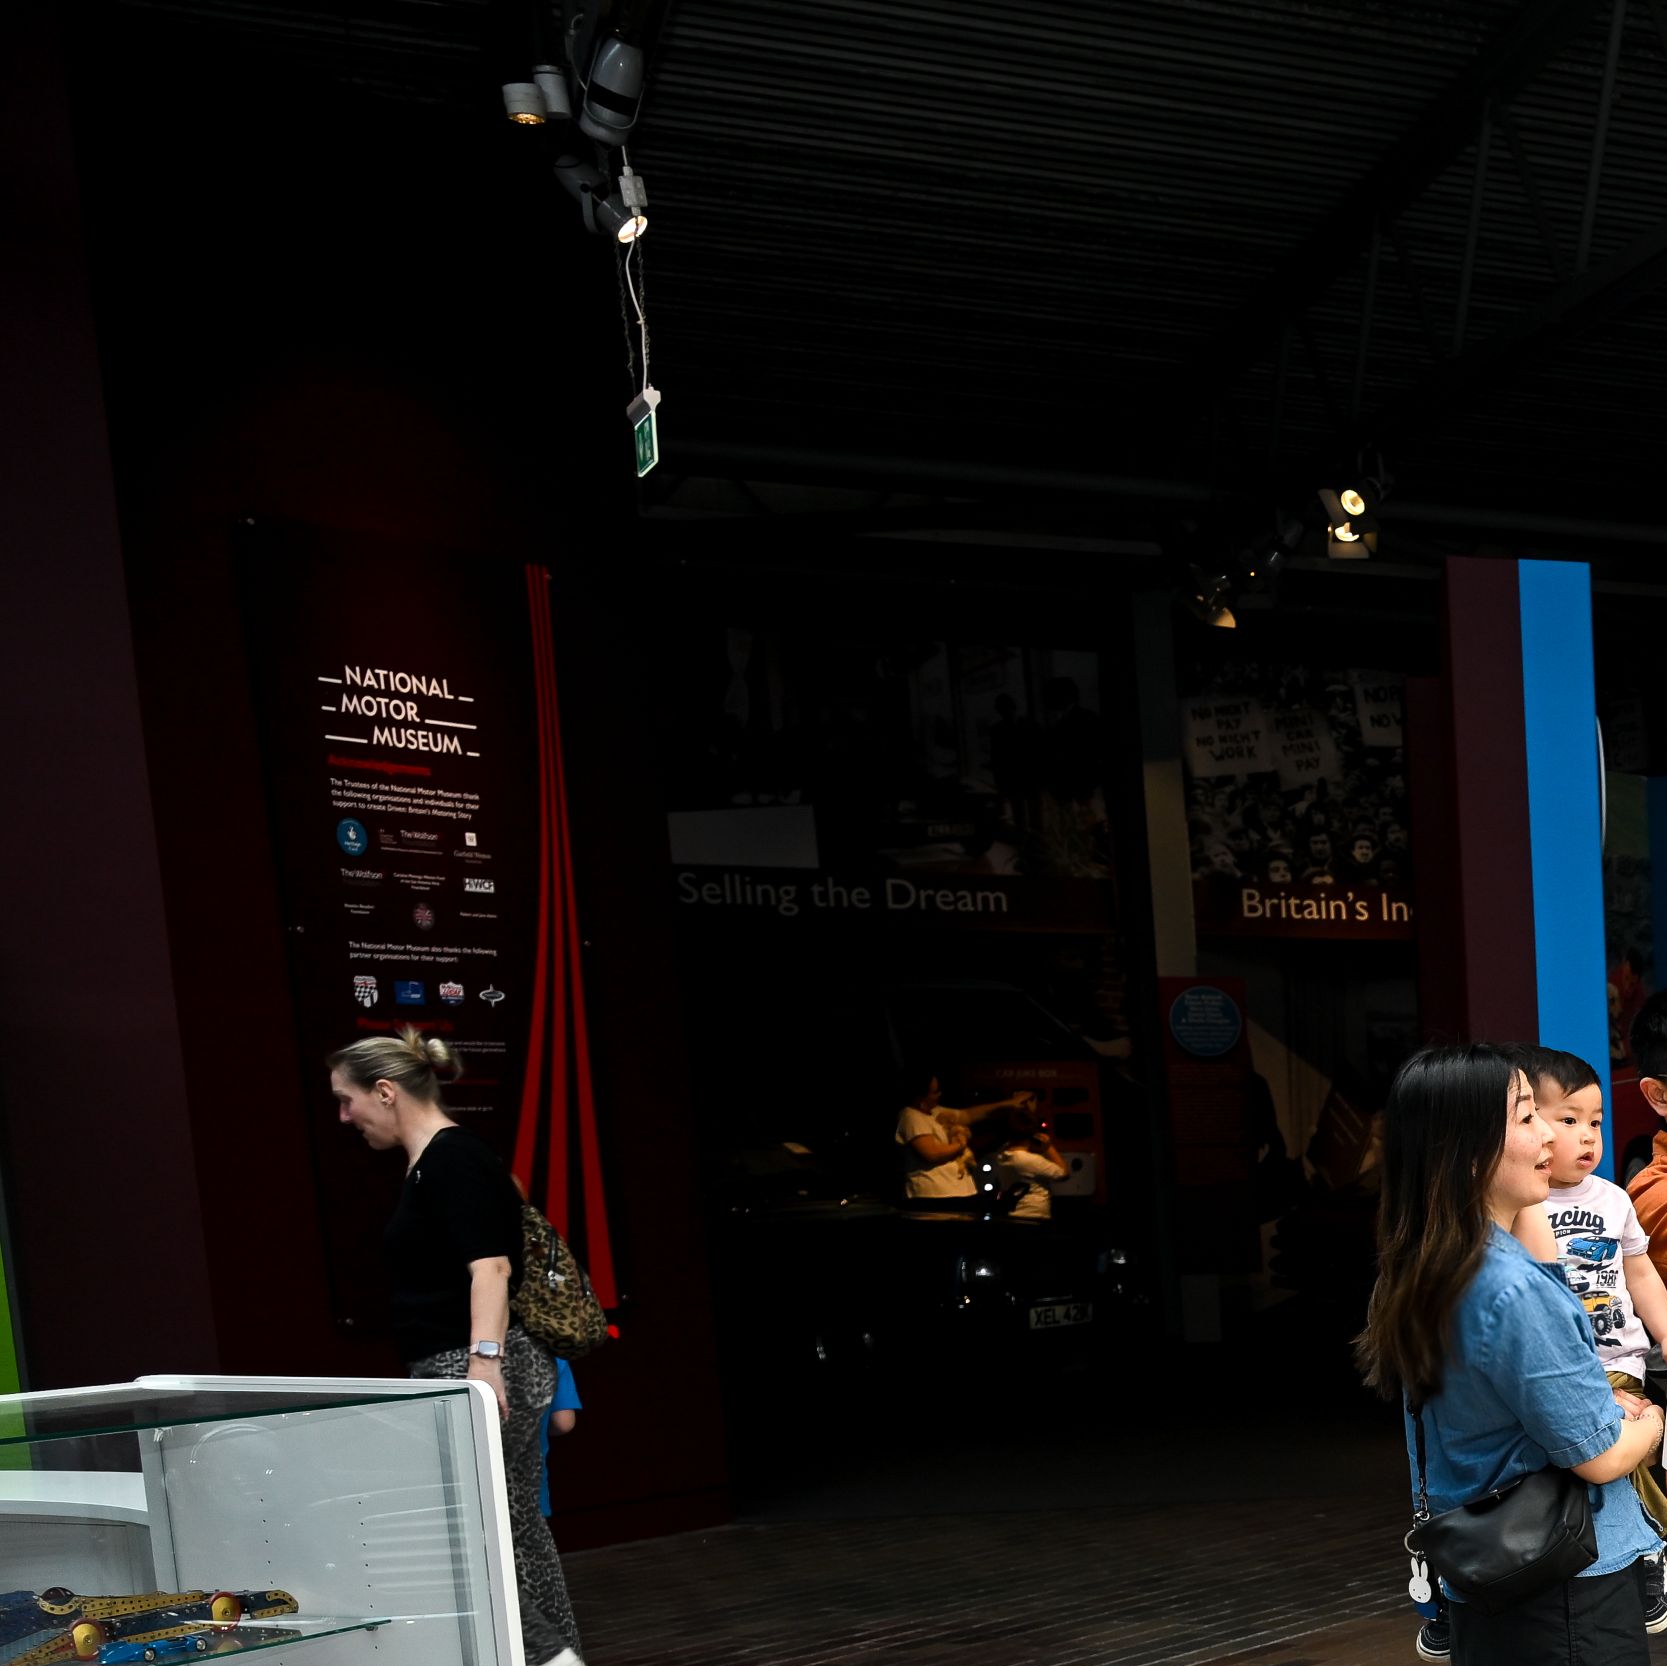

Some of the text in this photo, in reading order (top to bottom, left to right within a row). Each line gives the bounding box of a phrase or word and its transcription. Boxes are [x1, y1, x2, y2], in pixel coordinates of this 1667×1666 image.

[344, 664, 455, 700] NATIONAL
[341, 693, 421, 722] MOTOR
[373, 725, 463, 755] MUSEUM
[330, 777, 343, 787] The
[391, 784, 416, 794] National
[417, 787, 437, 796] Motor
[437, 789, 462, 798] Museum
[343, 790, 371, 801] following
[677, 871, 1009, 918] Selling the Dream
[1240, 887, 1414, 922] Britain's In
[1548, 1205, 1607, 1236] cing
